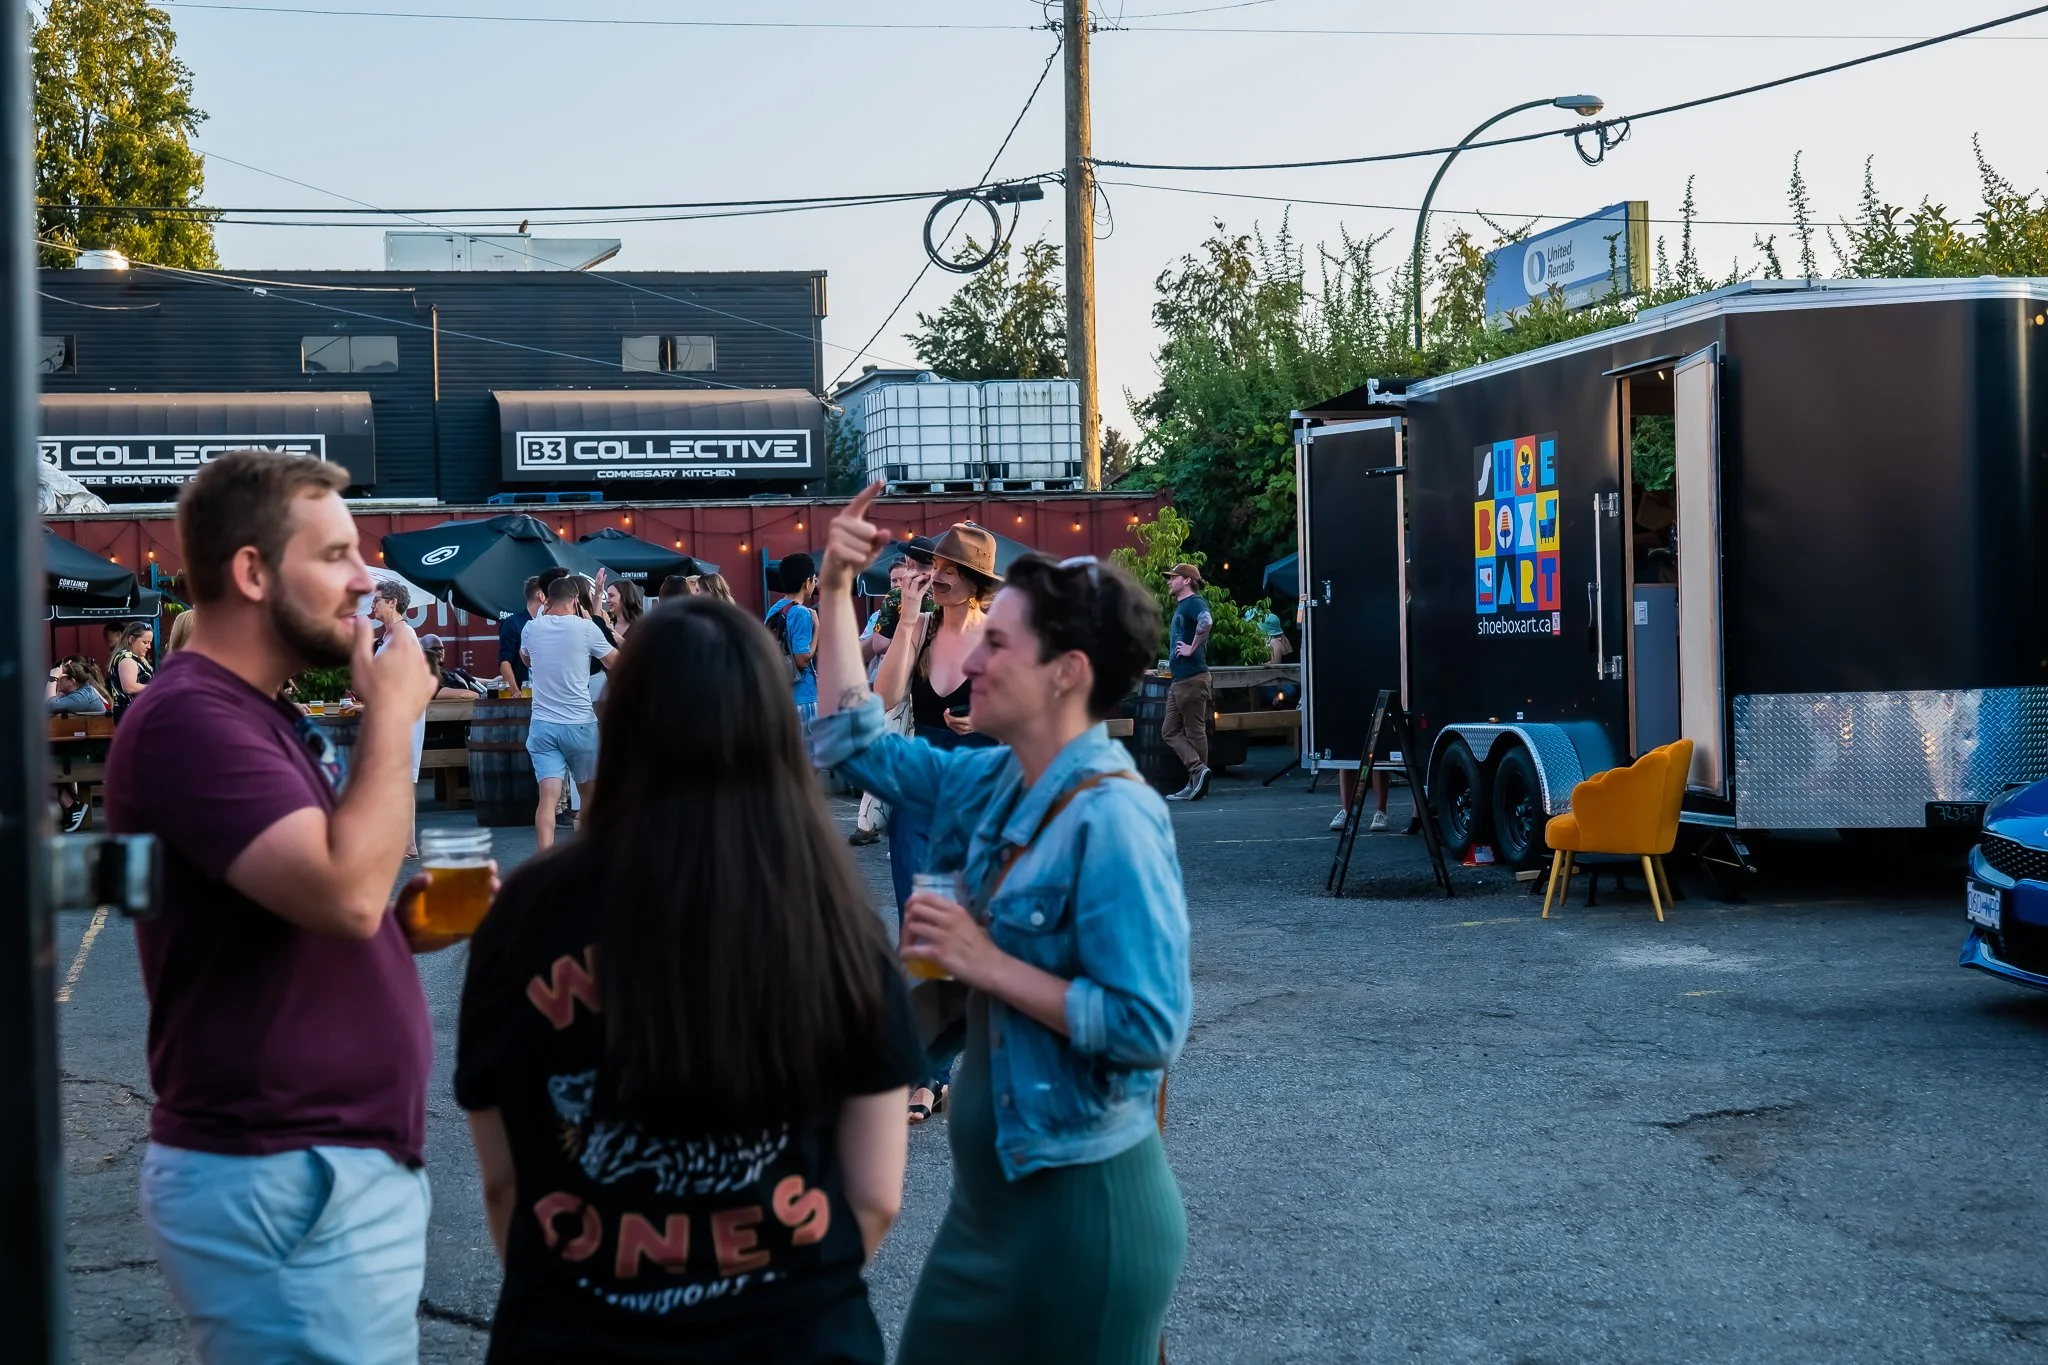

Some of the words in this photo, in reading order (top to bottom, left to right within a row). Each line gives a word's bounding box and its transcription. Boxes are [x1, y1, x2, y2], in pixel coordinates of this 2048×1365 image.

[1547, 240, 1573, 262] United
[1547, 259, 1575, 280] Rentals
[527, 441, 563, 461] B3
[573, 439, 798, 460] COLLECTIVE
[112, 475, 184, 485] ROASTING
[597, 470, 677, 478] COMMISSARY
[682, 469, 736, 478] KITCHEN
[59, 578, 89, 589] CONTAINER
[1498, 557, 1557, 605] ART
[1478, 614, 1551, 635] shoeboxart.ca
[533, 1174, 831, 1279] ONES
